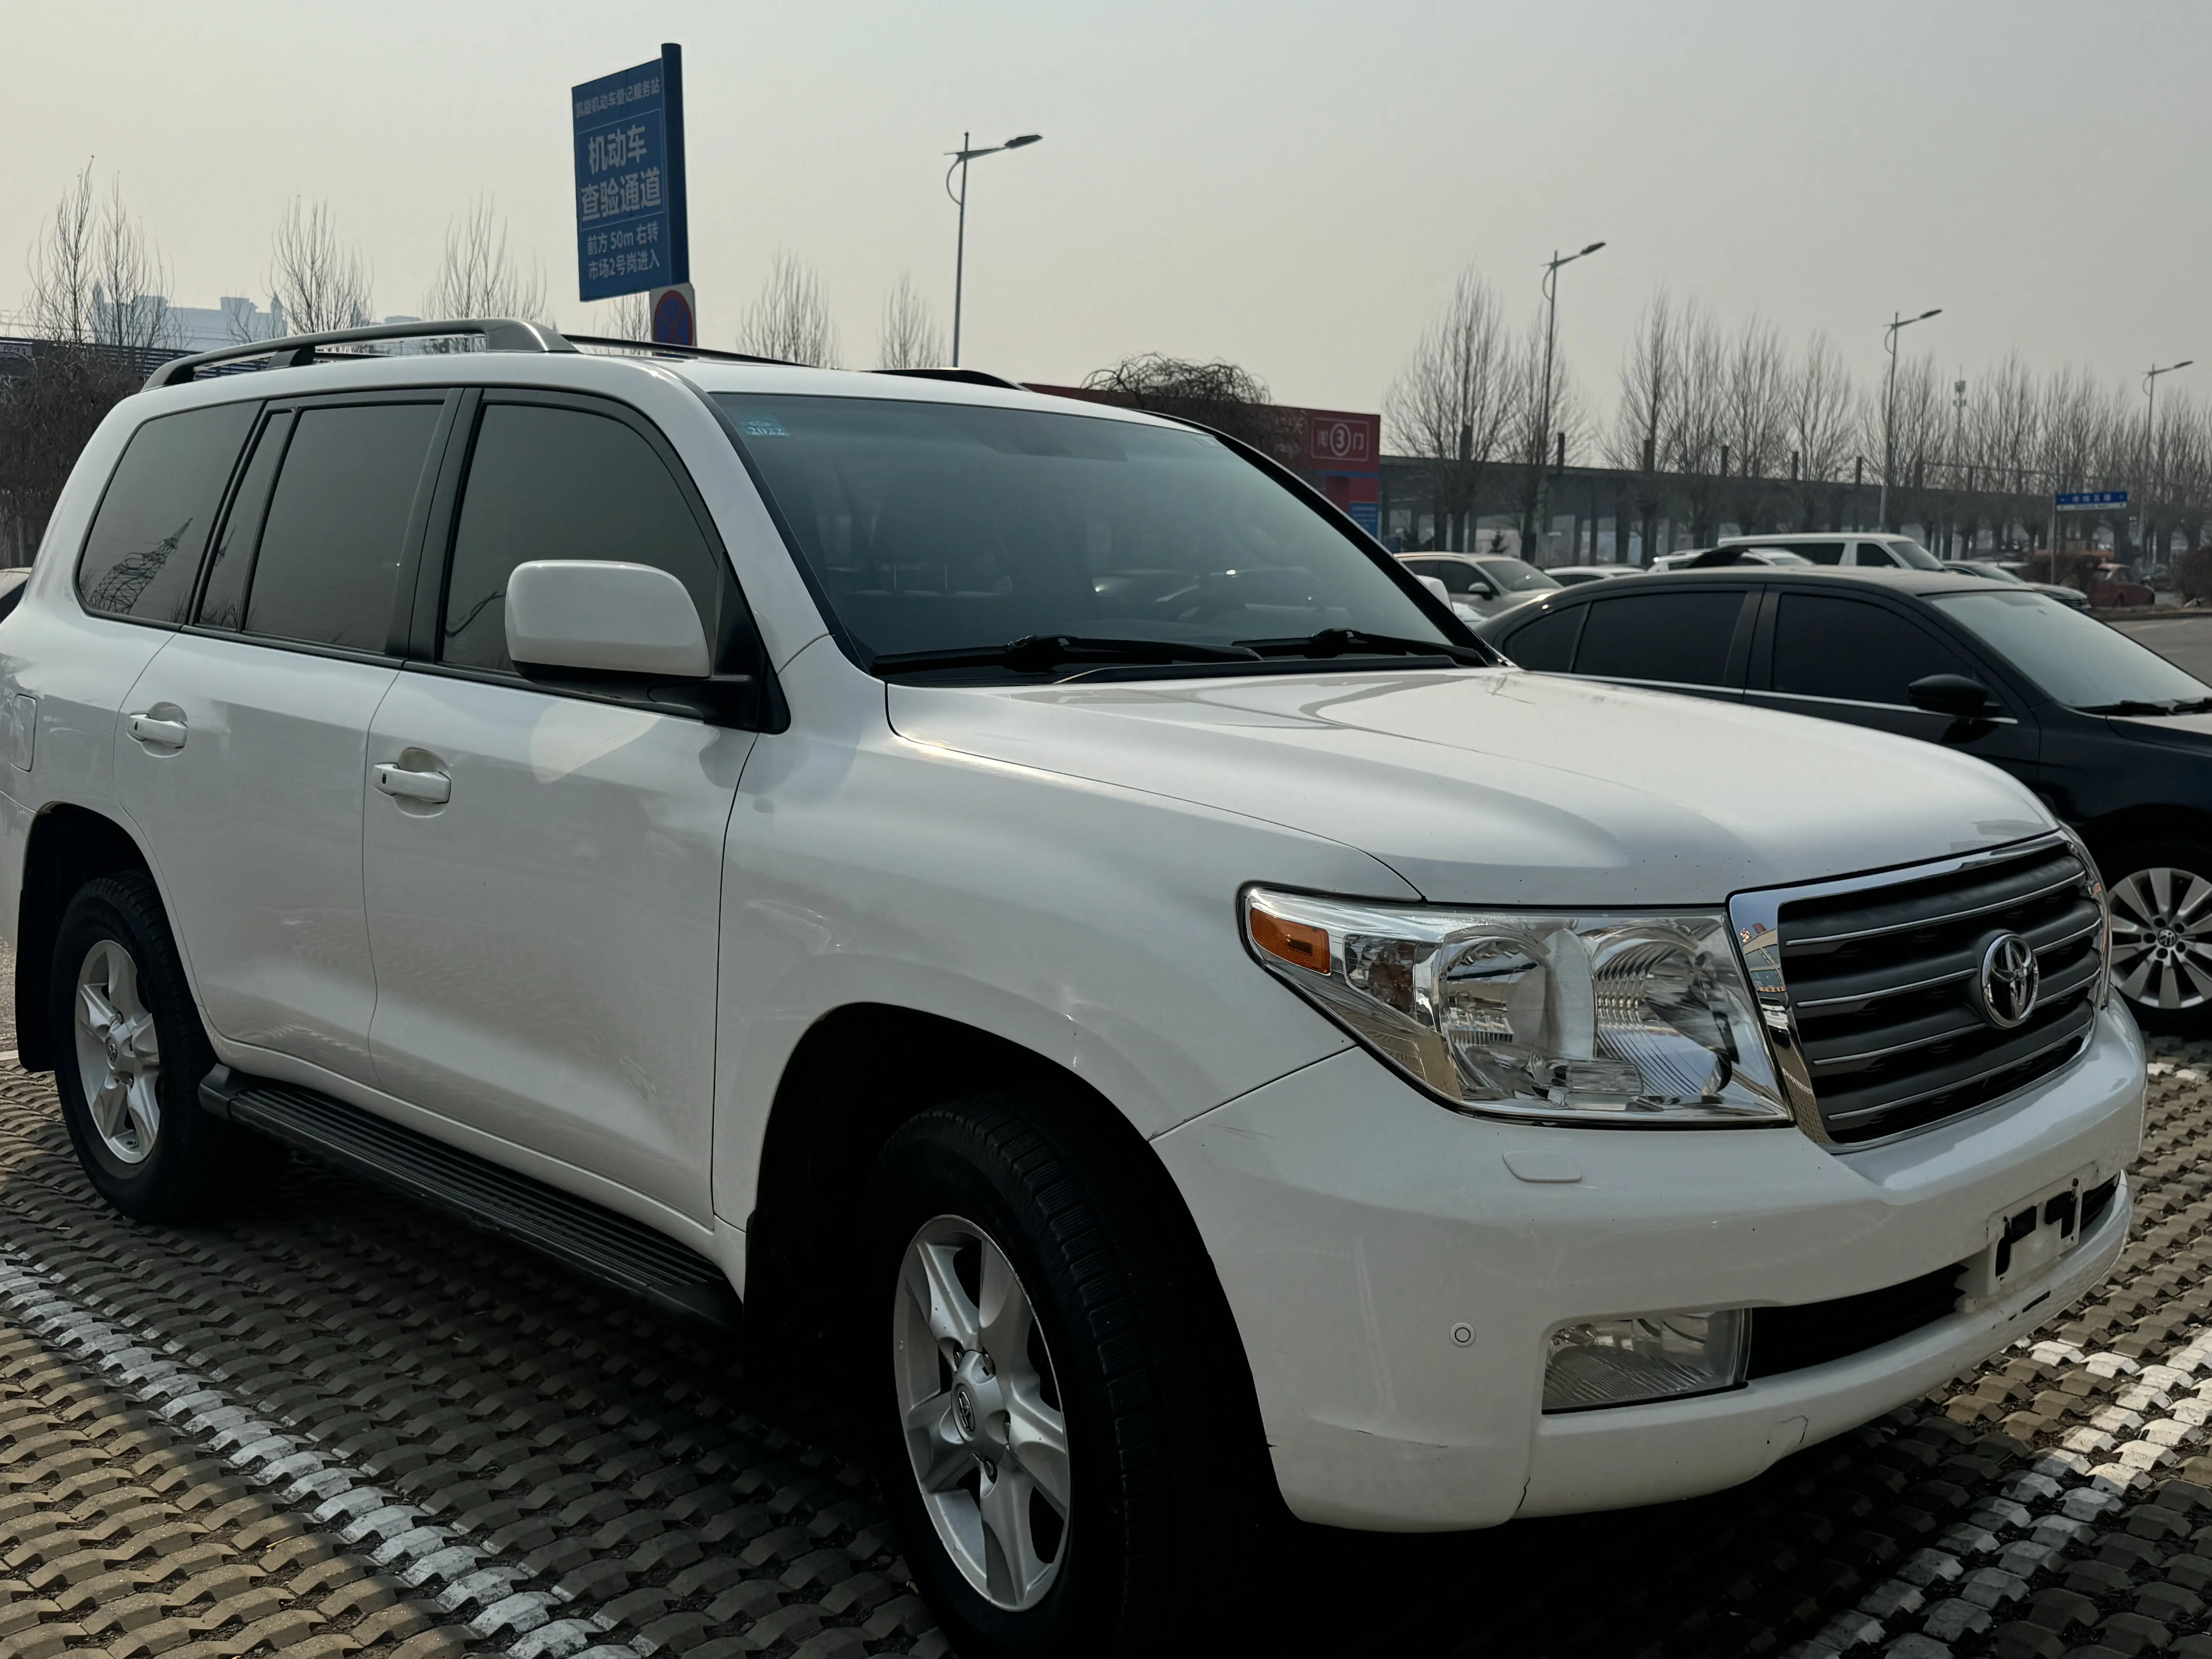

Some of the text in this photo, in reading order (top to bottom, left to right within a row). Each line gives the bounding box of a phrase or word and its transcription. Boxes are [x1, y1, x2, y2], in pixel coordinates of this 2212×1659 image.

[589, 124, 647, 175] 机动车
[581, 167, 661, 222] 查验通道
[587, 220, 658, 256] 前方 50m 右转
[588, 249, 660, 280] 市场2号岗进入
[747, 427, 785, 435] 2022
